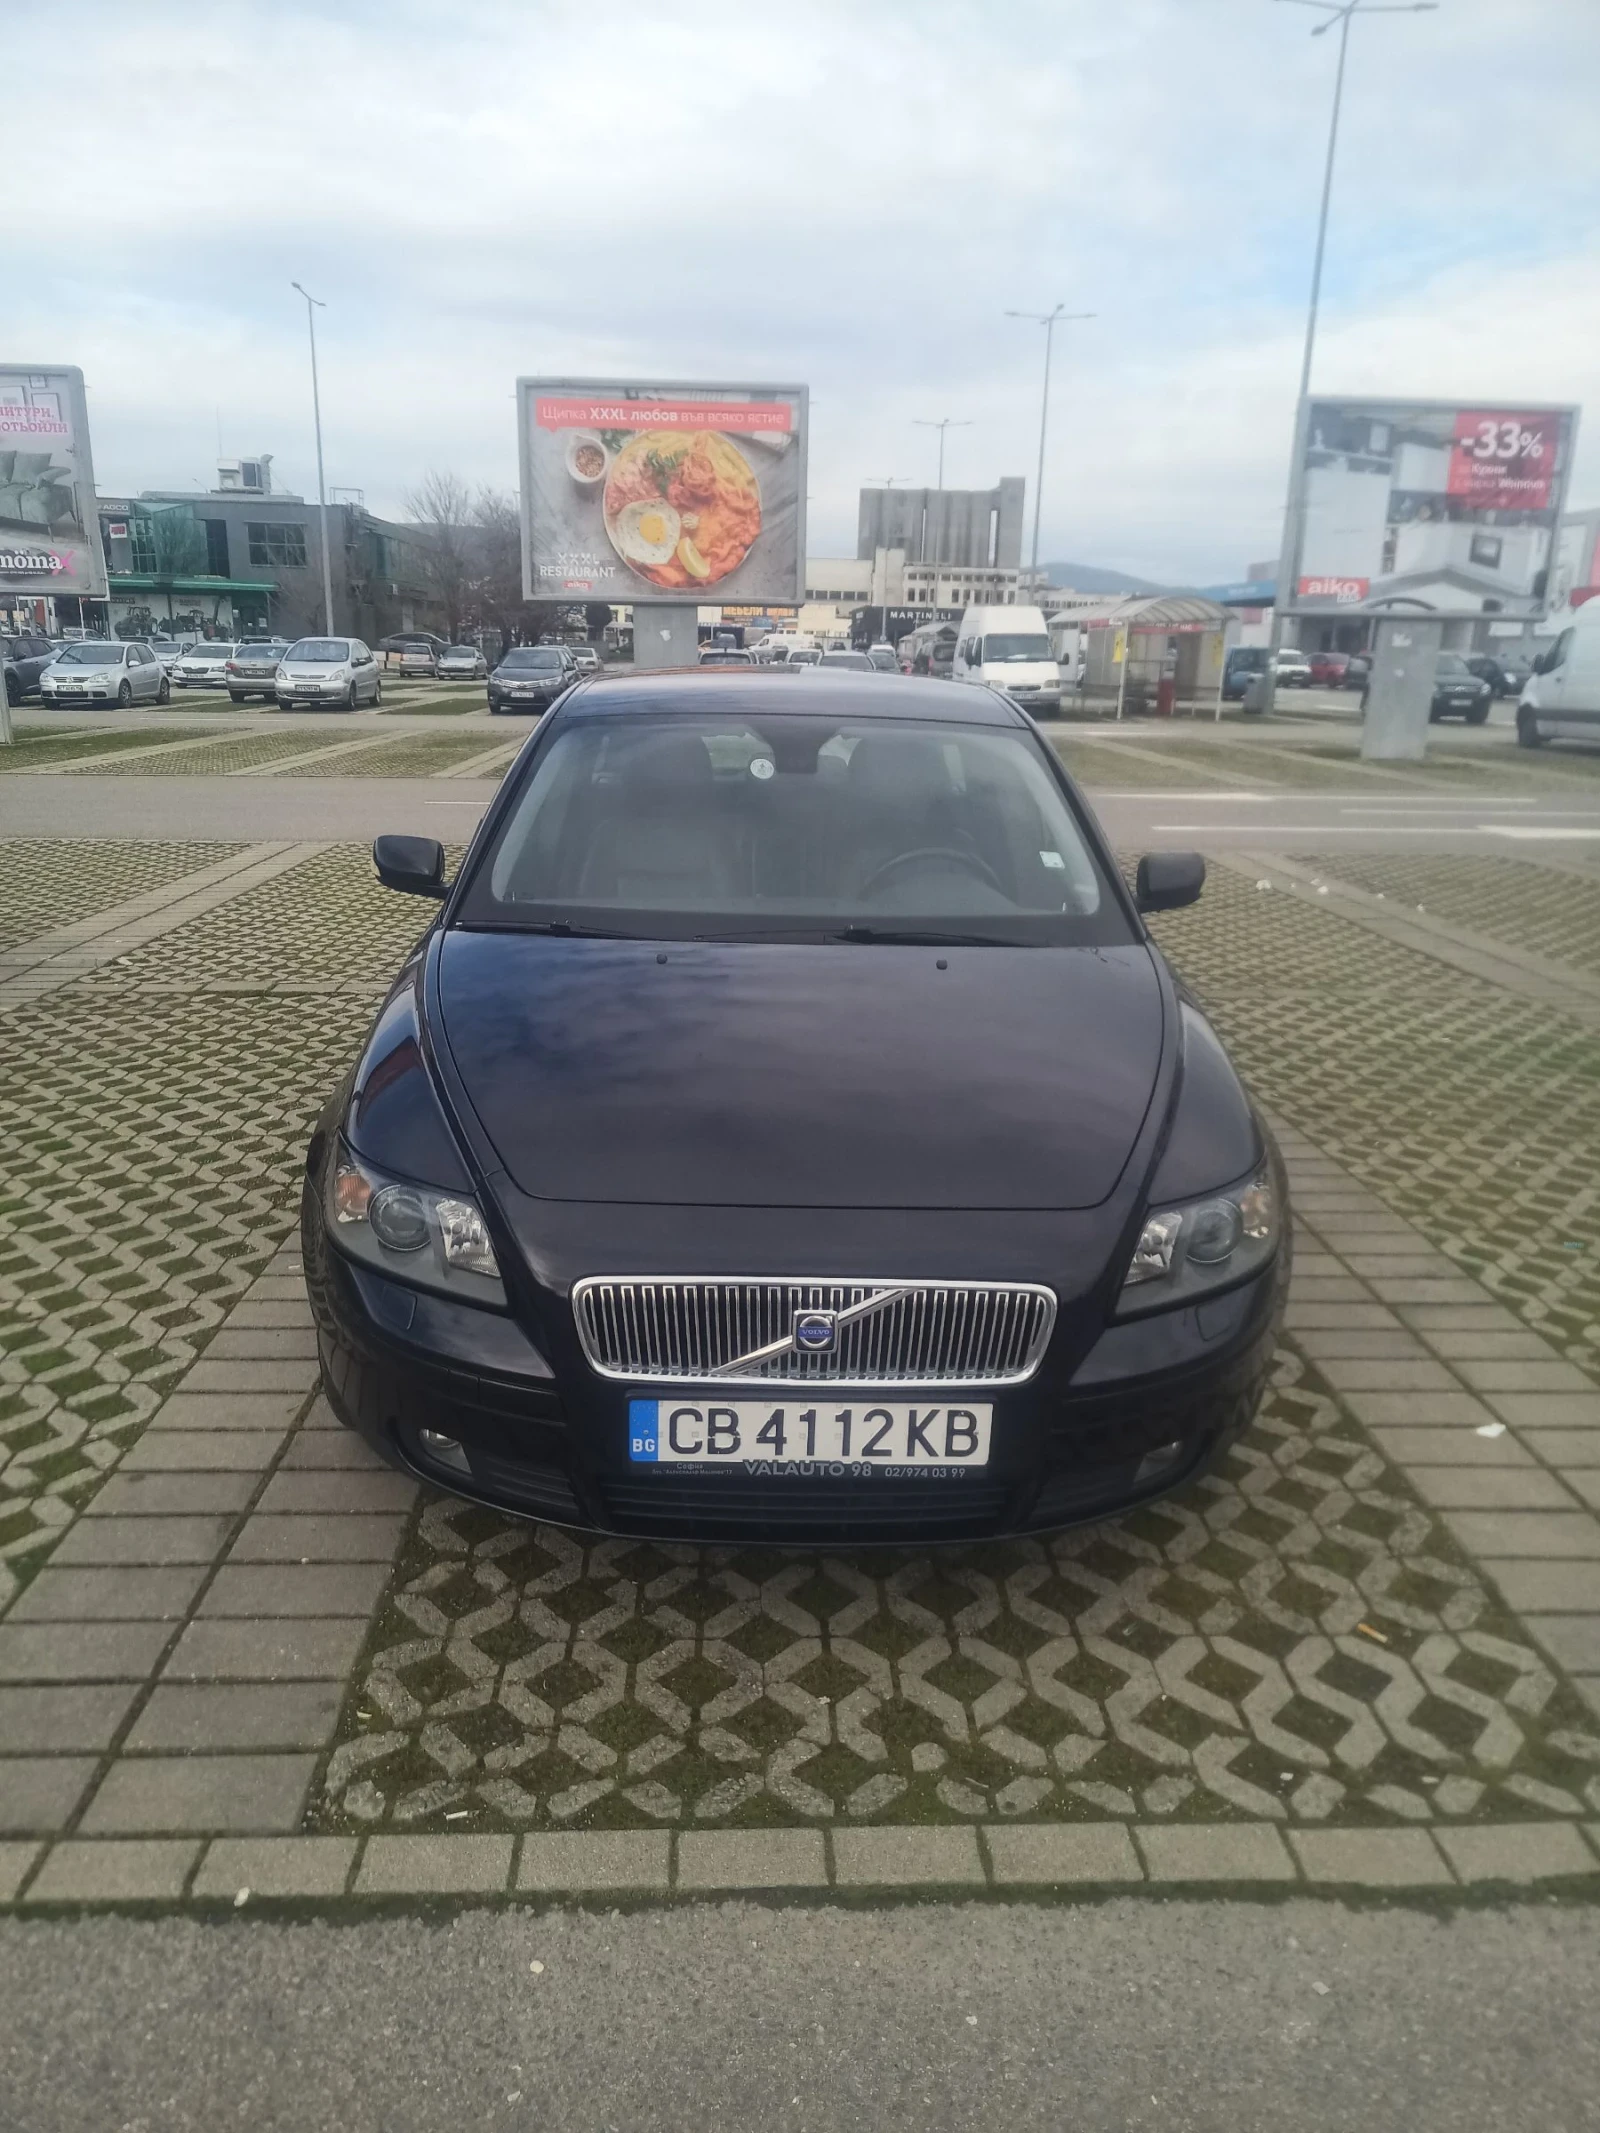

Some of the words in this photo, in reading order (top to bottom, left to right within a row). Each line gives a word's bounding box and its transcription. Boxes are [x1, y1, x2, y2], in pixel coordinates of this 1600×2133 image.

[590, 407, 626, 420] XXXL
[631, 409, 678, 421] любов
[0, 420, 68, 433] ОТЬОЙЛИ
[1460, 420, 1544, 458] -33%
[557, 553, 600, 564] XXXL
[540, 565, 615, 578] RESTAURANT
[1308, 577, 1359, 594] aiko
[632, 1438, 656, 1452] BG
[743, 1460, 845, 1477] VALAUTO
[851, 1462, 872, 1477] 98
[884, 1467, 928, 1478] 02/974
[932, 1468, 947, 1478] 03
[951, 1468, 966, 1478] 99
